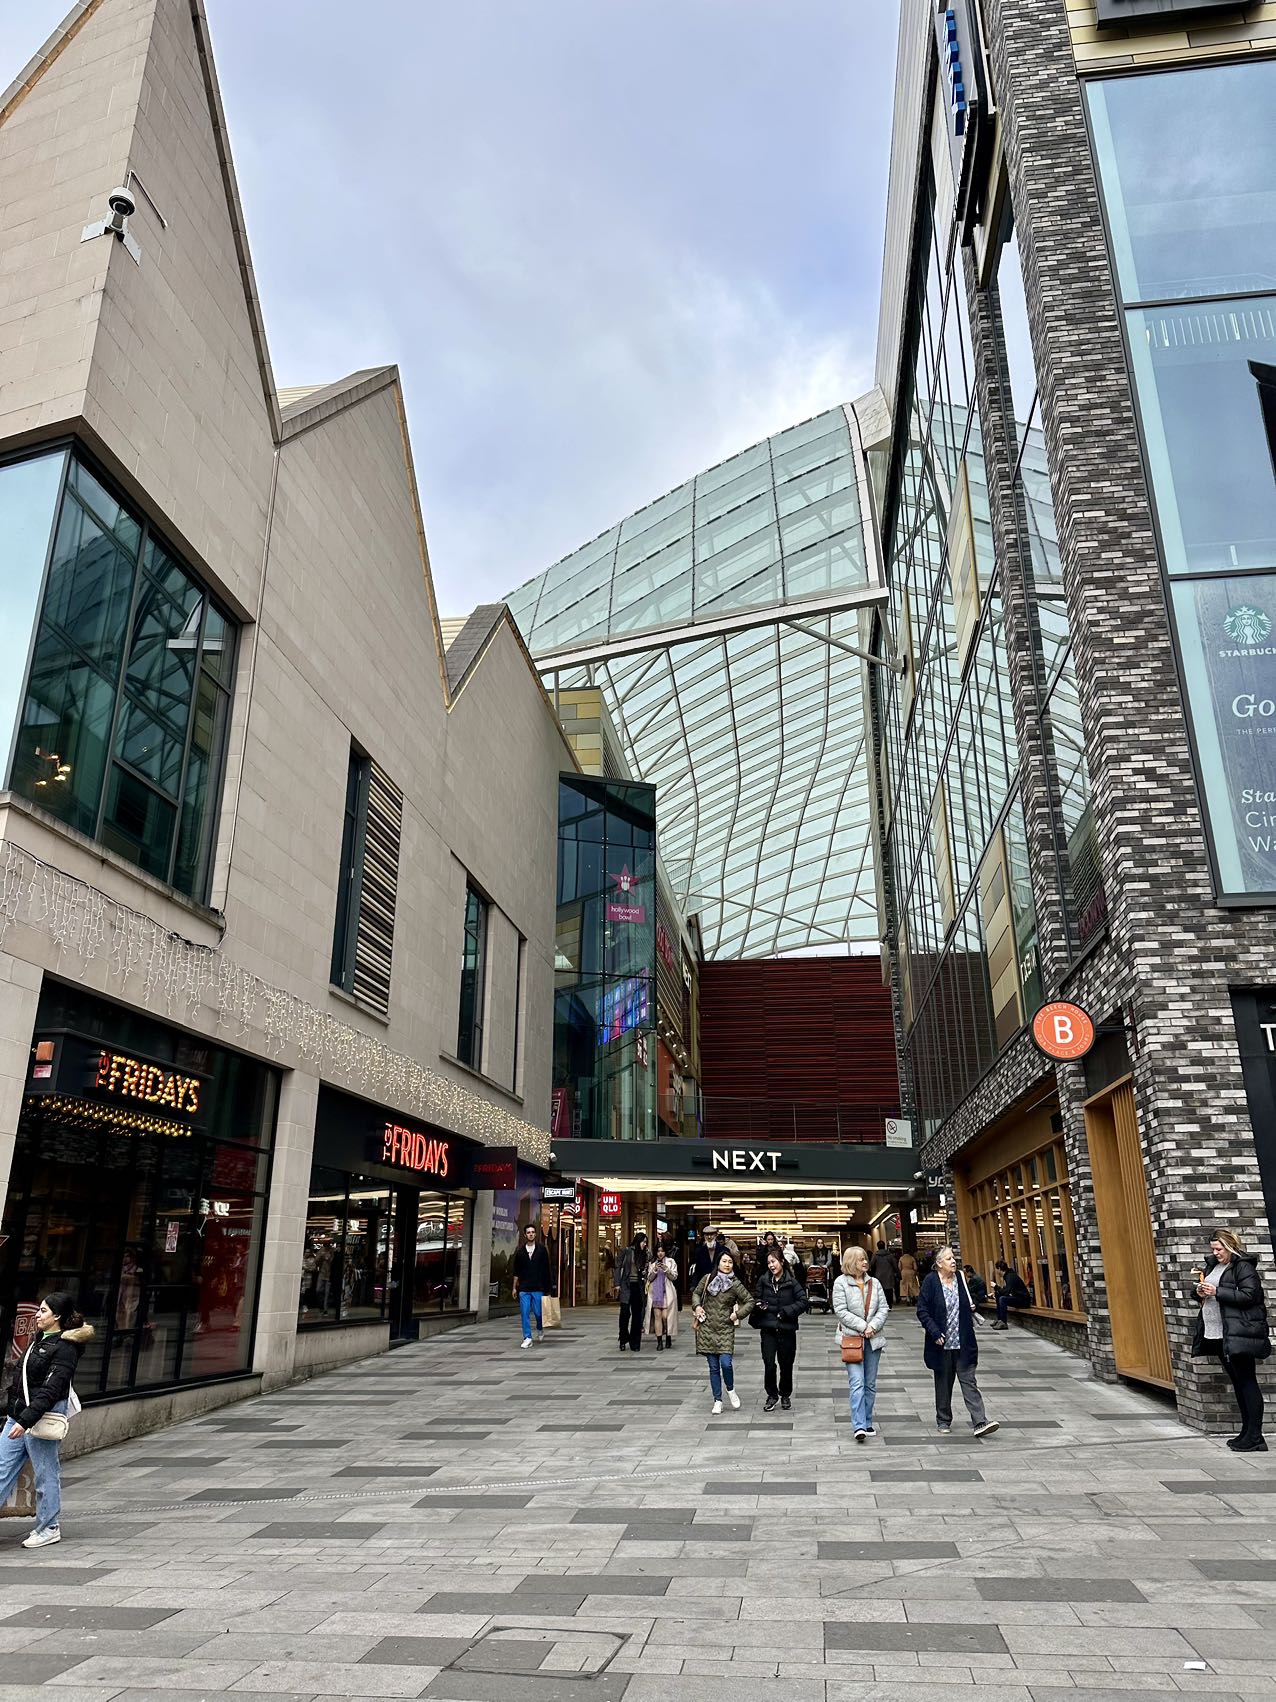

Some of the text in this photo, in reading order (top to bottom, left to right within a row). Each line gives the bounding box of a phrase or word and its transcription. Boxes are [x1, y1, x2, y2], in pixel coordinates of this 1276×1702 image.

[1232, 694, 1276, 718] Go
[610, 905, 640, 915] hollywood
[1053, 1015, 1074, 1044] B
[107, 1055, 200, 1113] FRIDAYS
[391, 1124, 449, 1177] FRIDAYS
[712, 1150, 782, 1172] NEXT
[602, 1196, 617, 1204] UNI
[602, 1204, 619, 1213] QLO
